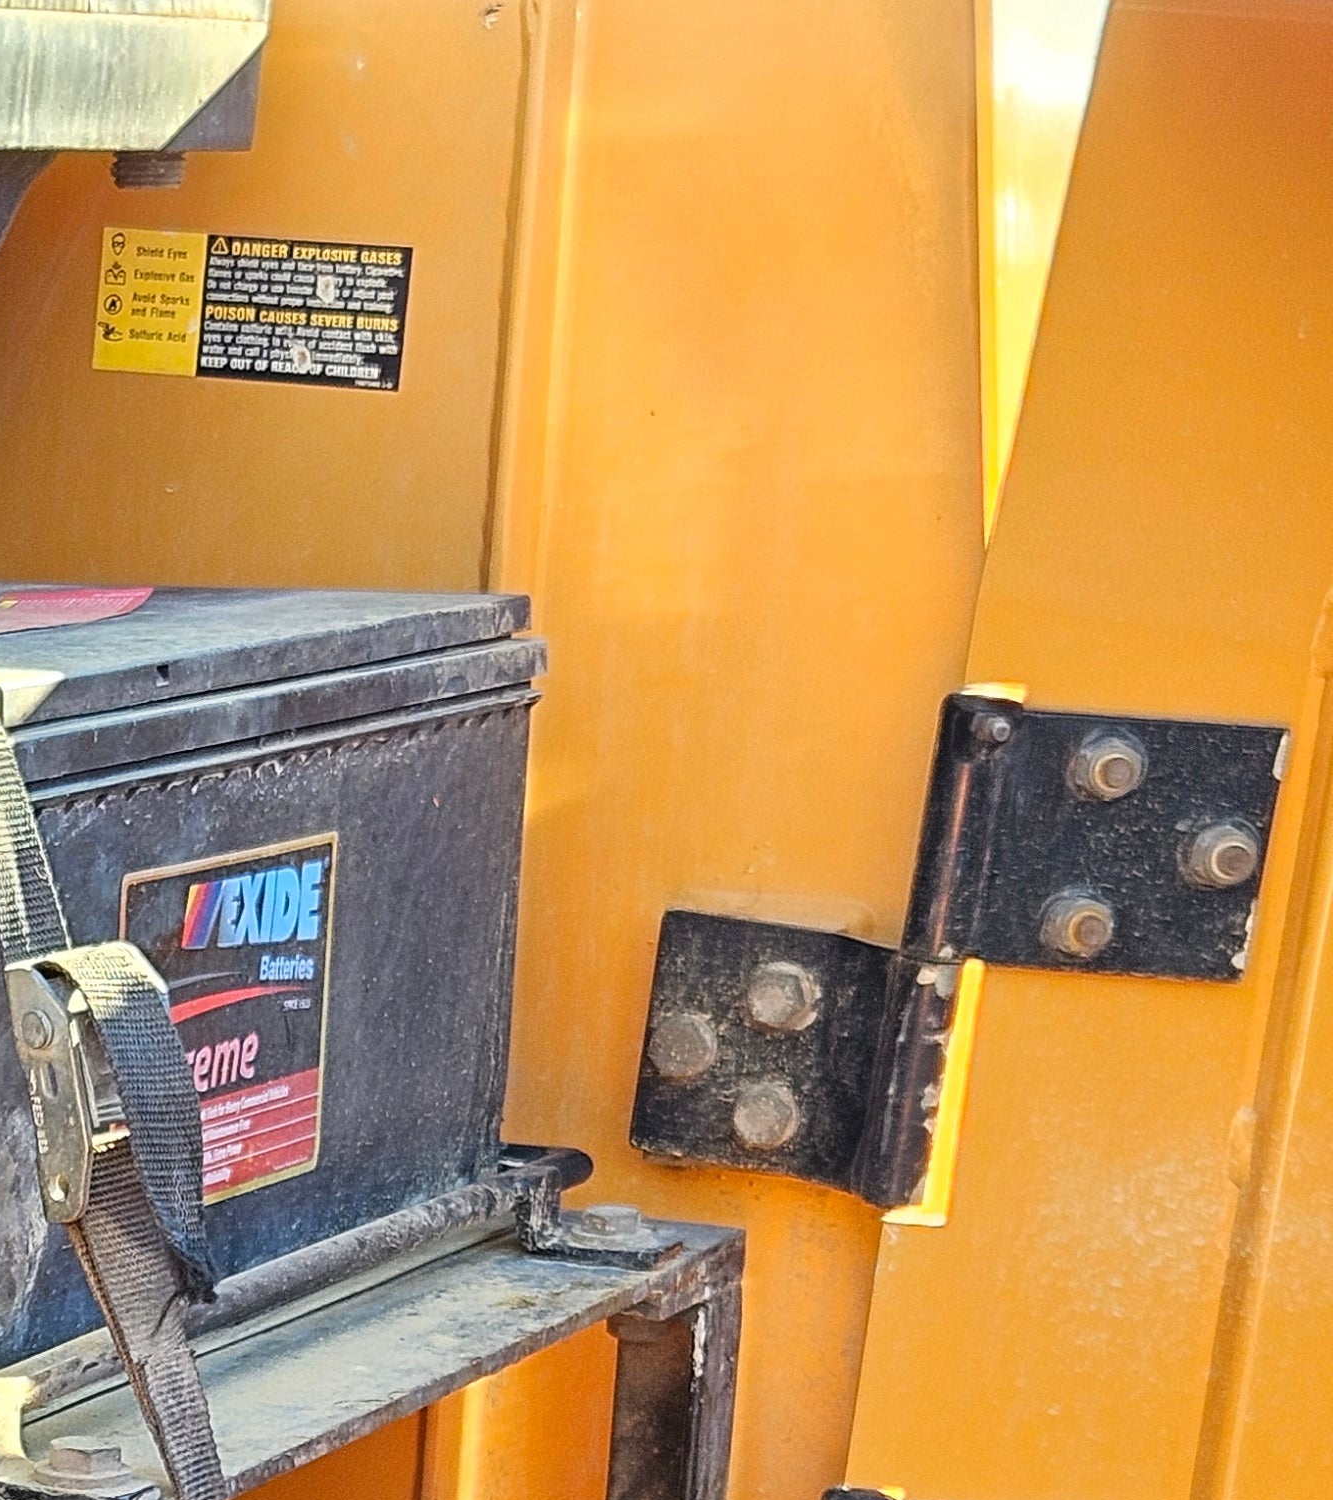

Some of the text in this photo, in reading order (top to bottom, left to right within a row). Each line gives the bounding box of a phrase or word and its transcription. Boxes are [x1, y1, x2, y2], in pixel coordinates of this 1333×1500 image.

[136, 246, 188, 261] Shield Eyes
[232, 242, 402, 265] DANGER EXPLOSIVE GASES
[134, 269, 196, 284] Explosive Gas
[132, 292, 191, 306] Avoid Sparks
[131, 307, 176, 319] and Flame
[205, 305, 399, 332] POISON CAUSES SEVERE BURNS
[128, 328, 187, 343] Sulfuric Acid
[200, 357, 228, 368] KEEP
[230, 358, 253, 371] OUT
[254, 359, 269, 371] OF
[325, 365, 382, 379] CHILDREN
[215, 860, 323, 949] EXIDE
[259, 953, 315, 981] Batteries
